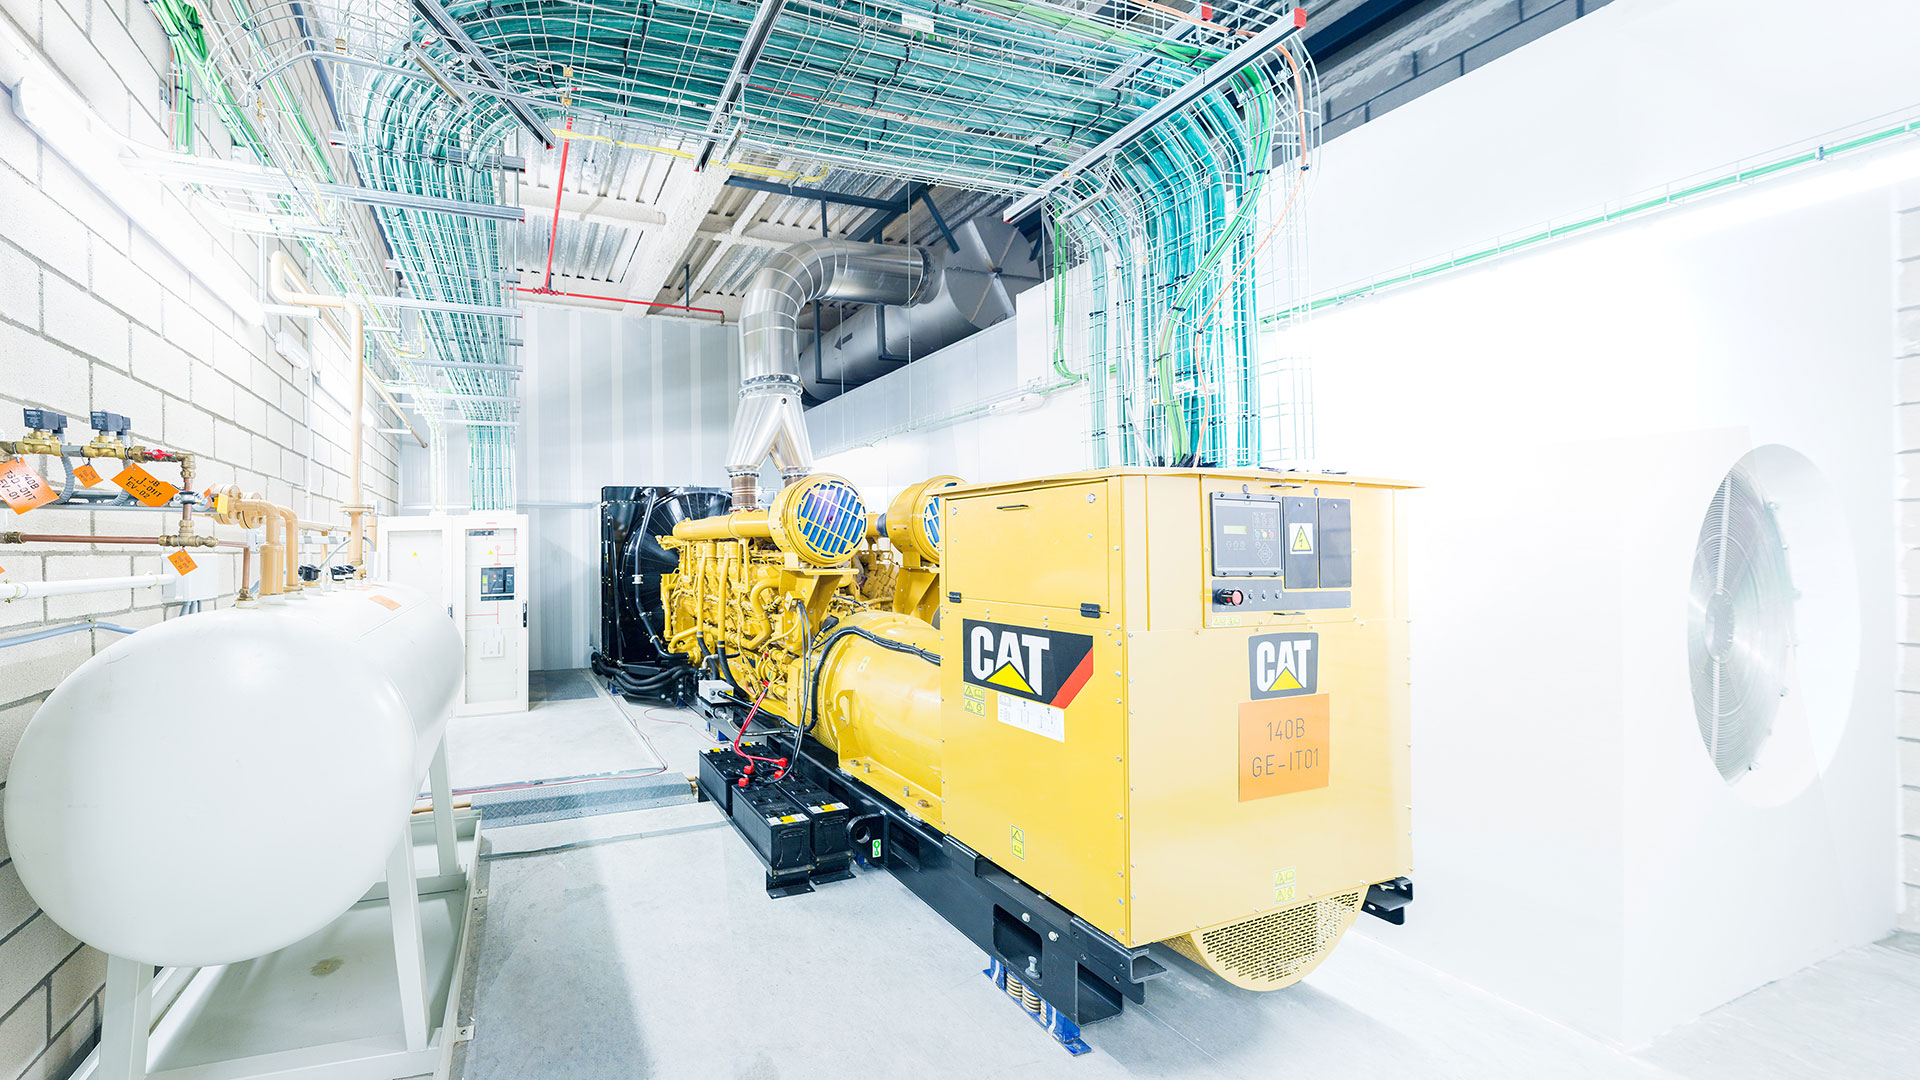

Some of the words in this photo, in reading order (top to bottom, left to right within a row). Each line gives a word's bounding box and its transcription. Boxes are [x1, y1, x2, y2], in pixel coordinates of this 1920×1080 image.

[970, 625, 1050, 696] CAT
[1256, 639, 1312, 692] CAT
[1267, 717, 1305, 742] 140B
[1252, 747, 1319, 778] GE-IT01
